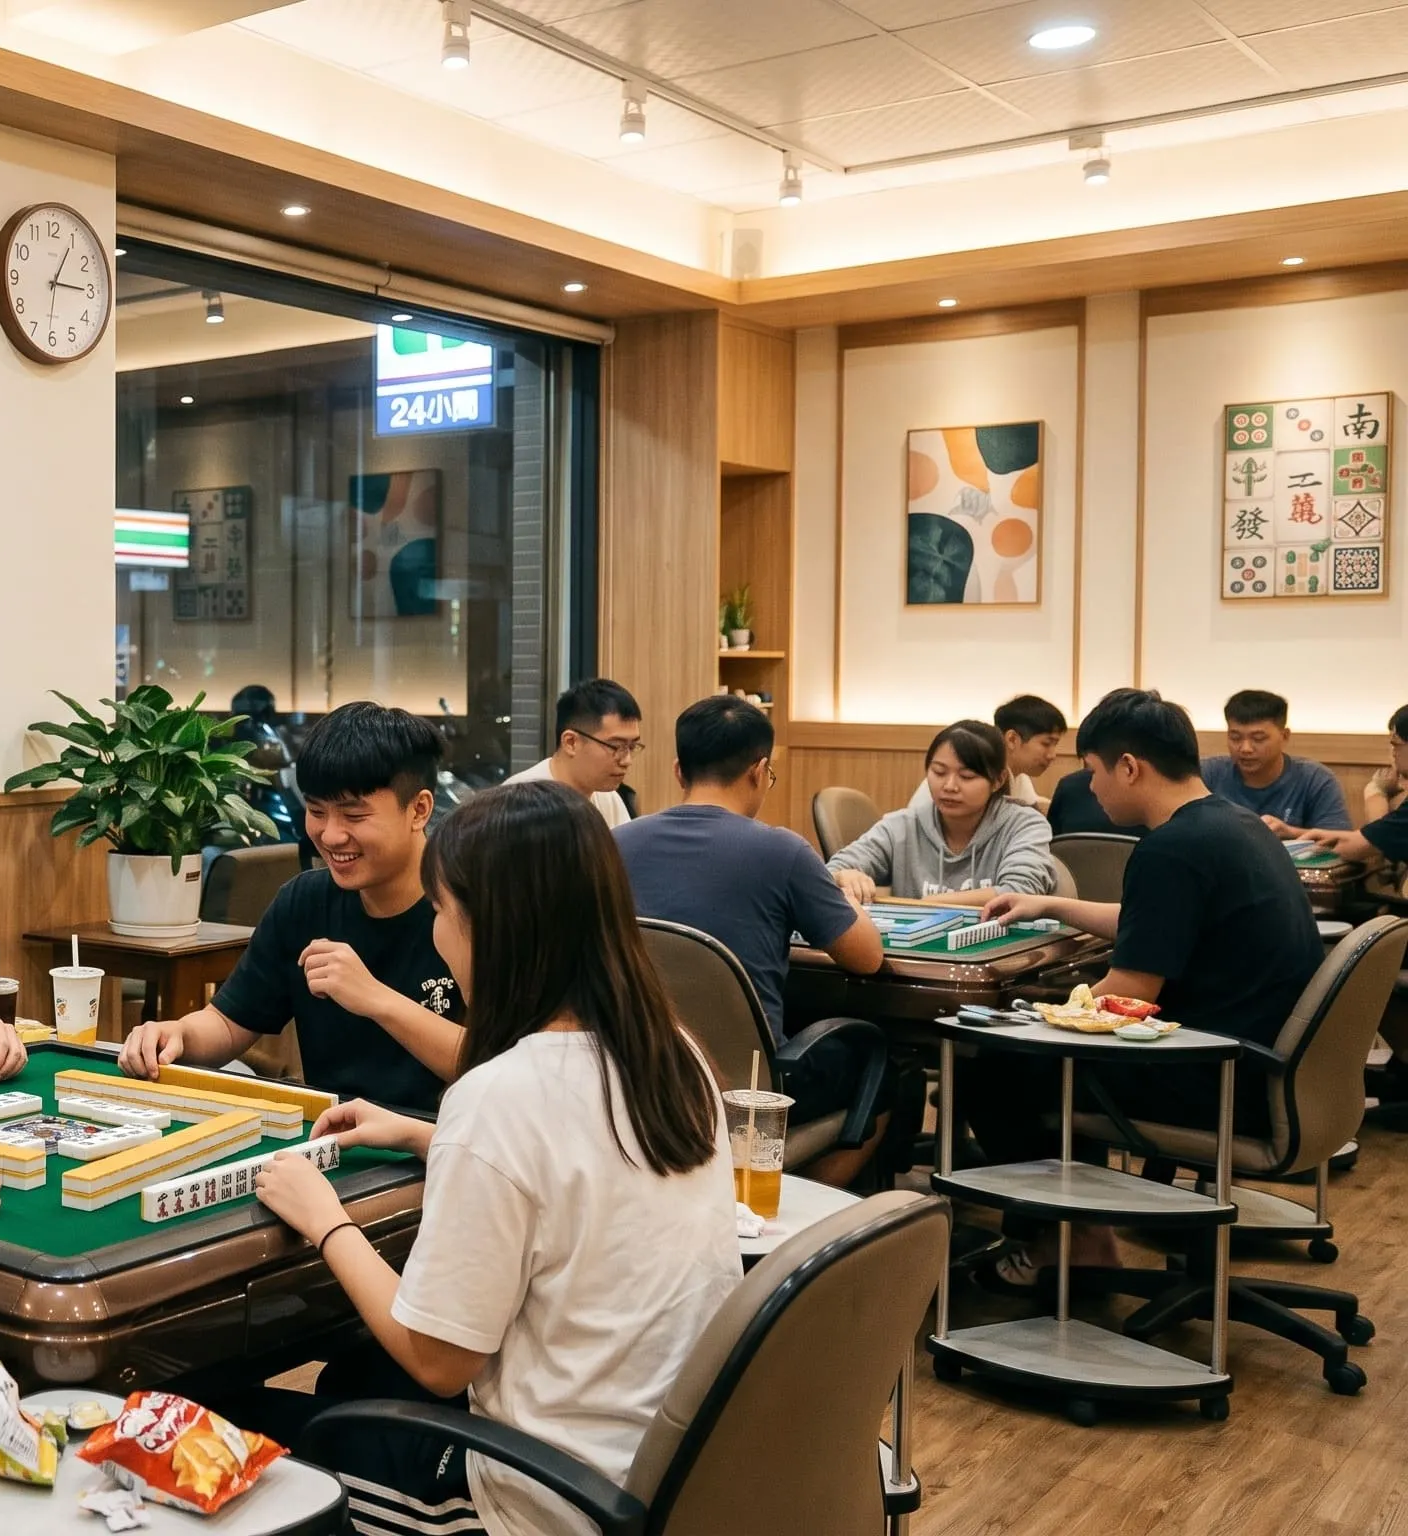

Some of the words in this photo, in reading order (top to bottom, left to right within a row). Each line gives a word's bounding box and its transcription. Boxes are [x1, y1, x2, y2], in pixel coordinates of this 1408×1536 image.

[29, 224, 40, 242] 11
[46, 220, 61, 239] 12
[70, 233, 76, 249] 1
[14, 242, 30, 261] 10
[80, 255, 89, 273] 2
[9, 269, 19, 286] 9
[86, 283, 95, 299] 3
[15, 297, 25, 314] 8
[80, 309, 90, 326] 4
[29, 320, 38, 337] 7
[67, 326, 77, 343] 5
[48, 330, 57, 347] 6
[1343, 403, 1380, 440] 南
[1231, 507, 1269, 540] 發
